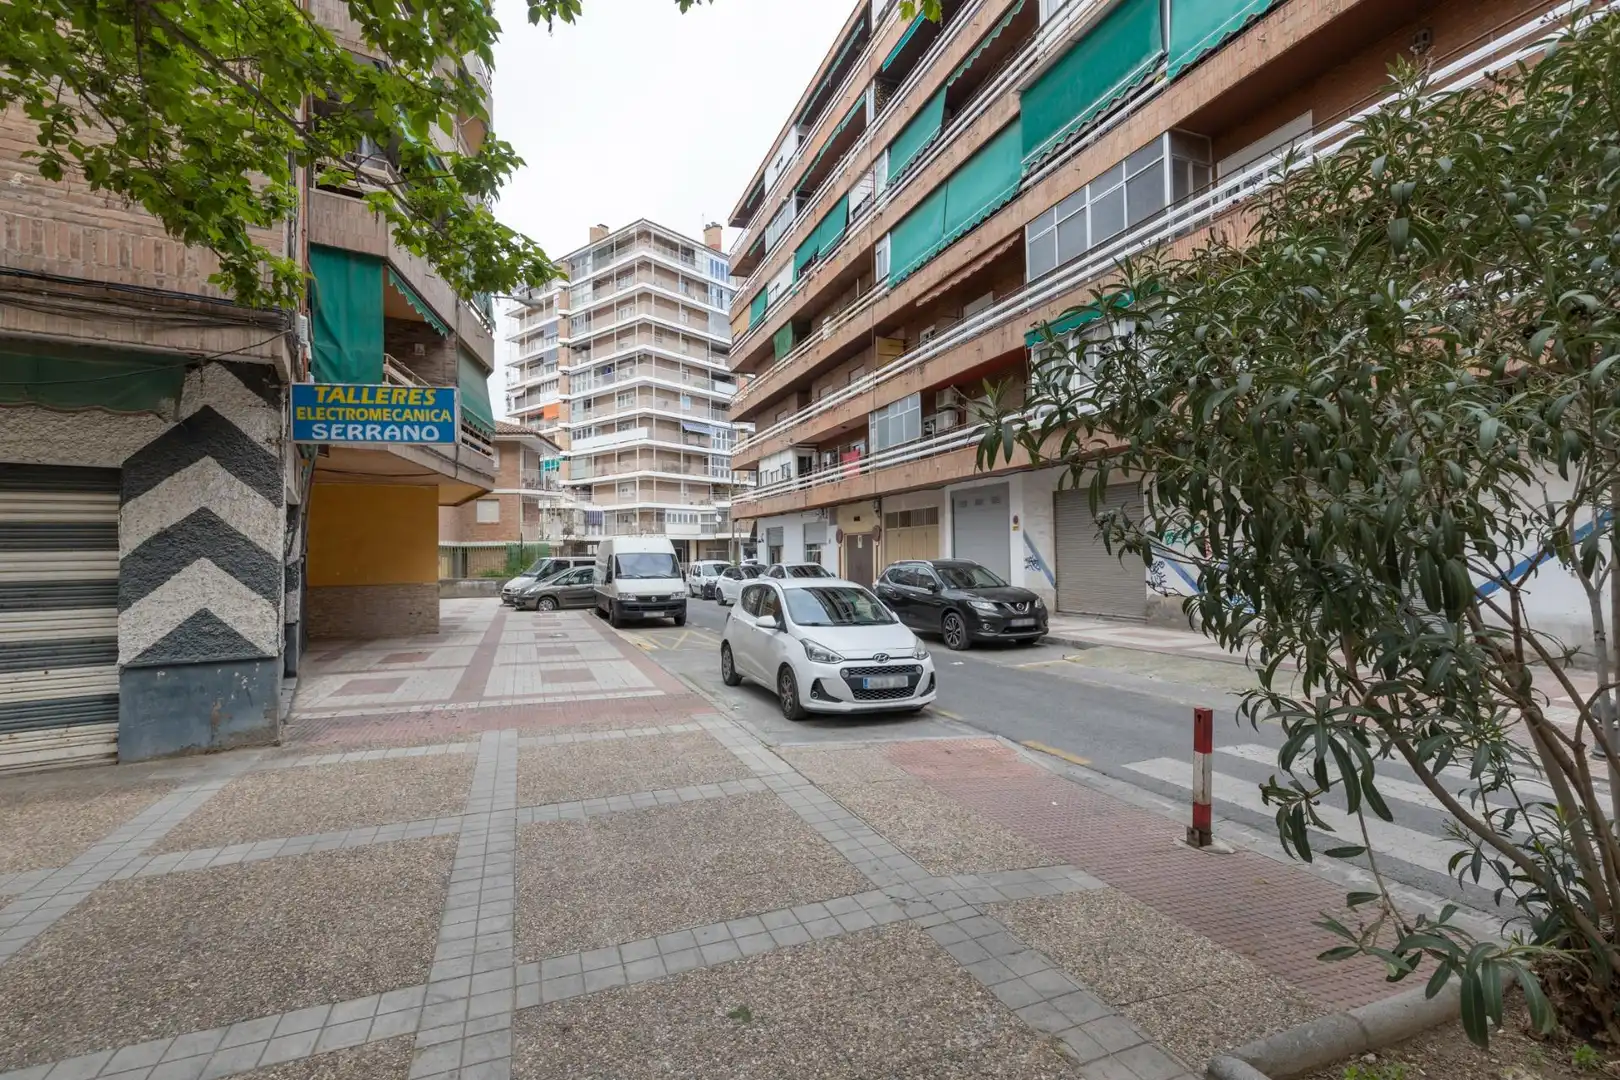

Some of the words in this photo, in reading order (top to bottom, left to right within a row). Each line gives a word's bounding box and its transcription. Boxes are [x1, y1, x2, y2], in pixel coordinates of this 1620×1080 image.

[314, 386, 437, 406] TALLERES
[296, 406, 453, 423] ELECTROMECANICA
[311, 423, 440, 441] SERRANO
